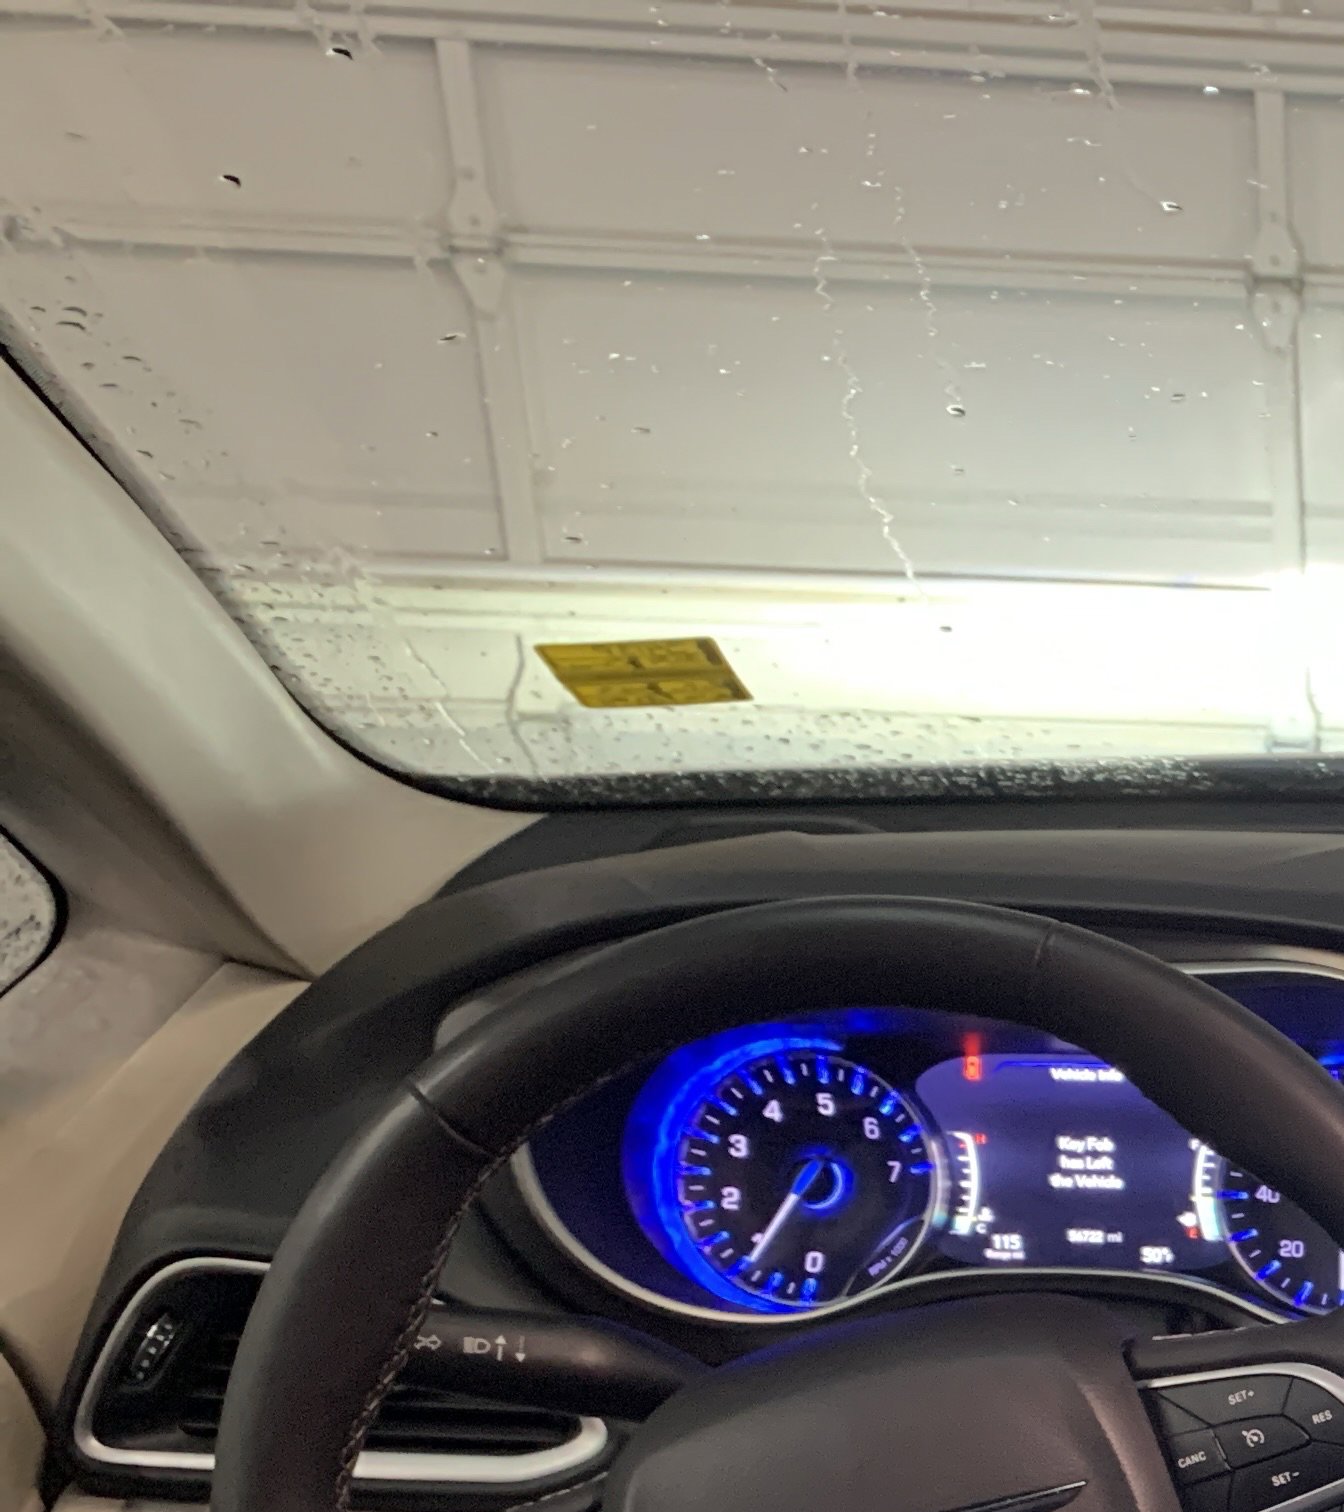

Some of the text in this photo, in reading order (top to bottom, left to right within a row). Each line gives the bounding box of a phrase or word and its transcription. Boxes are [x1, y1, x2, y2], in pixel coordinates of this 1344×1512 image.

[762, 1099, 784, 1123] 4
[815, 1092, 836, 1117] 5
[862, 1116, 881, 1140] 6
[727, 1133, 750, 1158] 3
[975, 1133, 988, 1146] H
[1055, 1135, 1116, 1152] Key Fob
[887, 1160, 902, 1183] 7
[1058, 1154, 1115, 1171] has Left
[1048, 1174, 1126, 1190] the Vehicle
[720, 1186, 741, 1211] 2
[990, 1233, 1023, 1250] 115
[1279, 1240, 1305, 1258] 20
[803, 1250, 825, 1274] 0
[1227, 1390, 1255, 1406] SET+
[1311, 1409, 1333, 1425] RES
[1177, 1450, 1207, 1469] CANC
